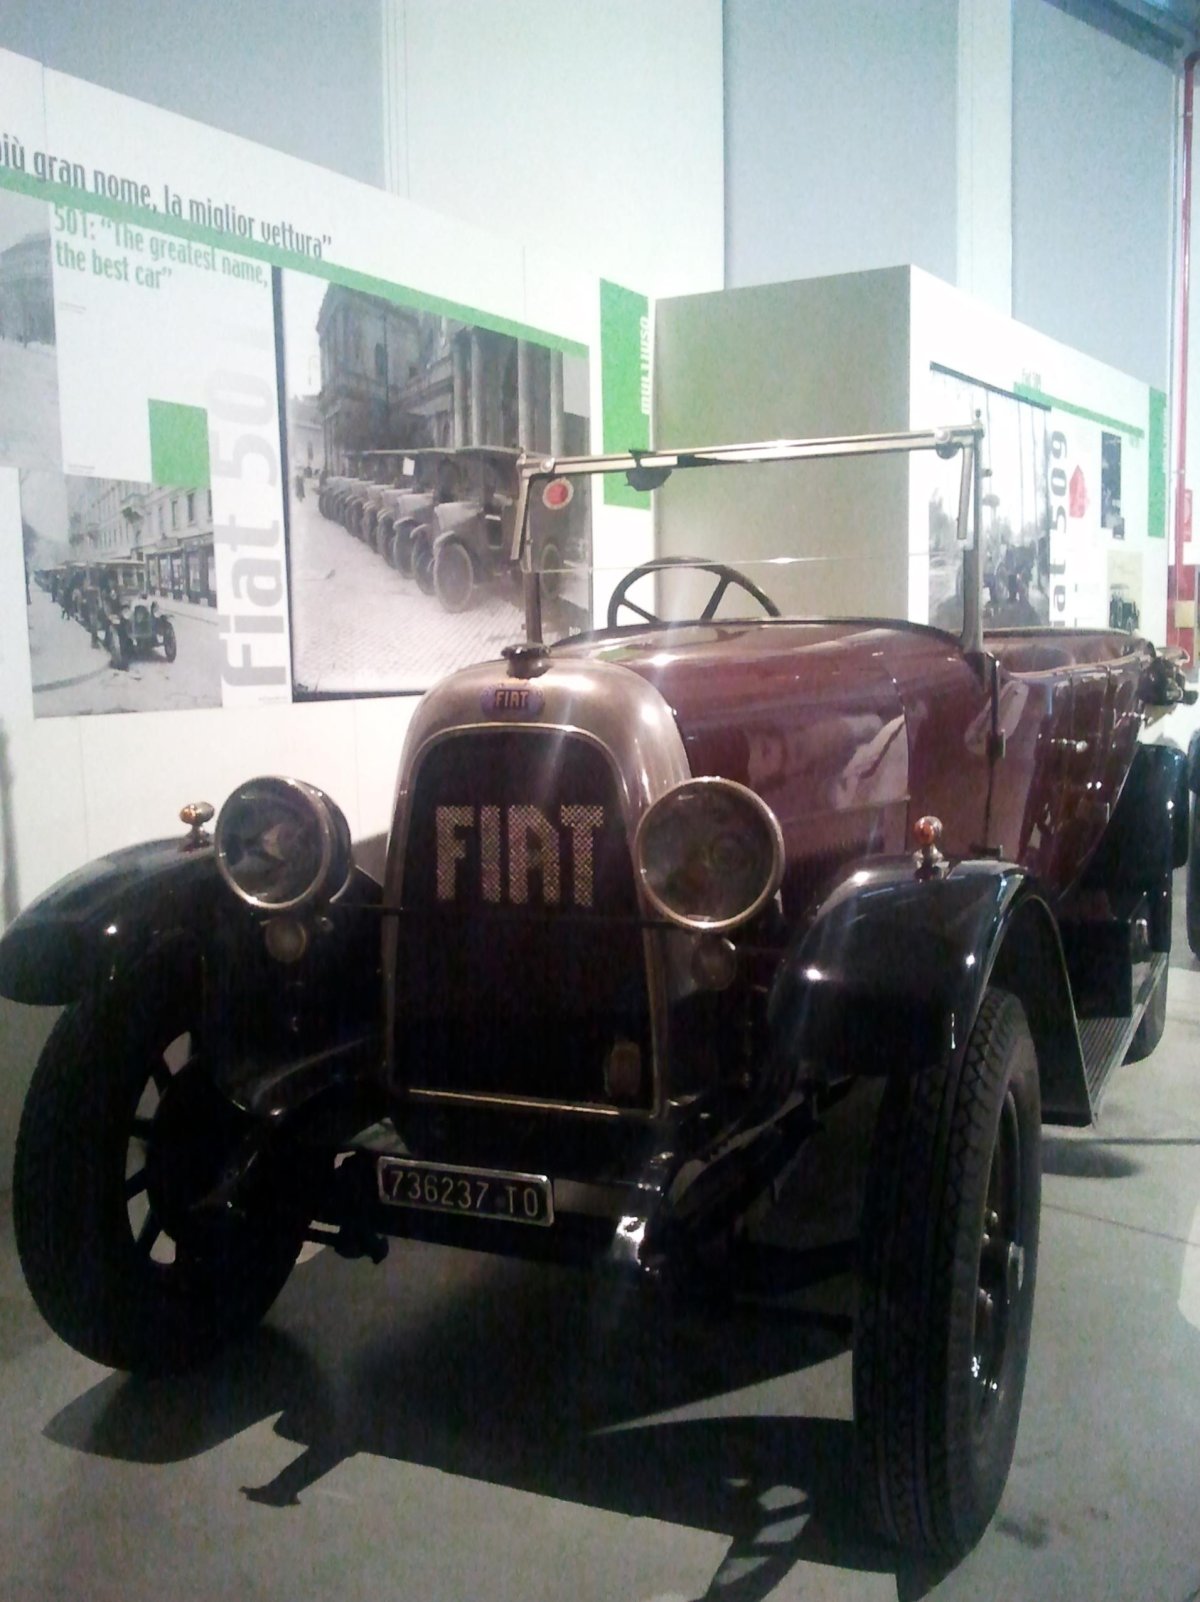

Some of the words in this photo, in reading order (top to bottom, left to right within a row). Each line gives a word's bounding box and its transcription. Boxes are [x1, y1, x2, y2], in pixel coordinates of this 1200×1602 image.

[0, 132, 25, 172] iù
[33, 151, 87, 191] gran
[93, 168, 157, 214] nome,
[164, 184, 183, 218] la
[189, 198, 256, 239] miglior
[55, 240, 86, 272] the
[92, 248, 129, 282] best
[149, 235, 217, 272] greatest
[222, 254, 268, 288] name,
[1050, 430, 1068, 535] 509
[1049, 558, 1067, 628] iat
[495, 690, 530, 707] FIAT
[435, 805, 604, 907] FIAT
[390, 1170, 489, 1209] 736237
[505, 1185, 539, 1218] TO
